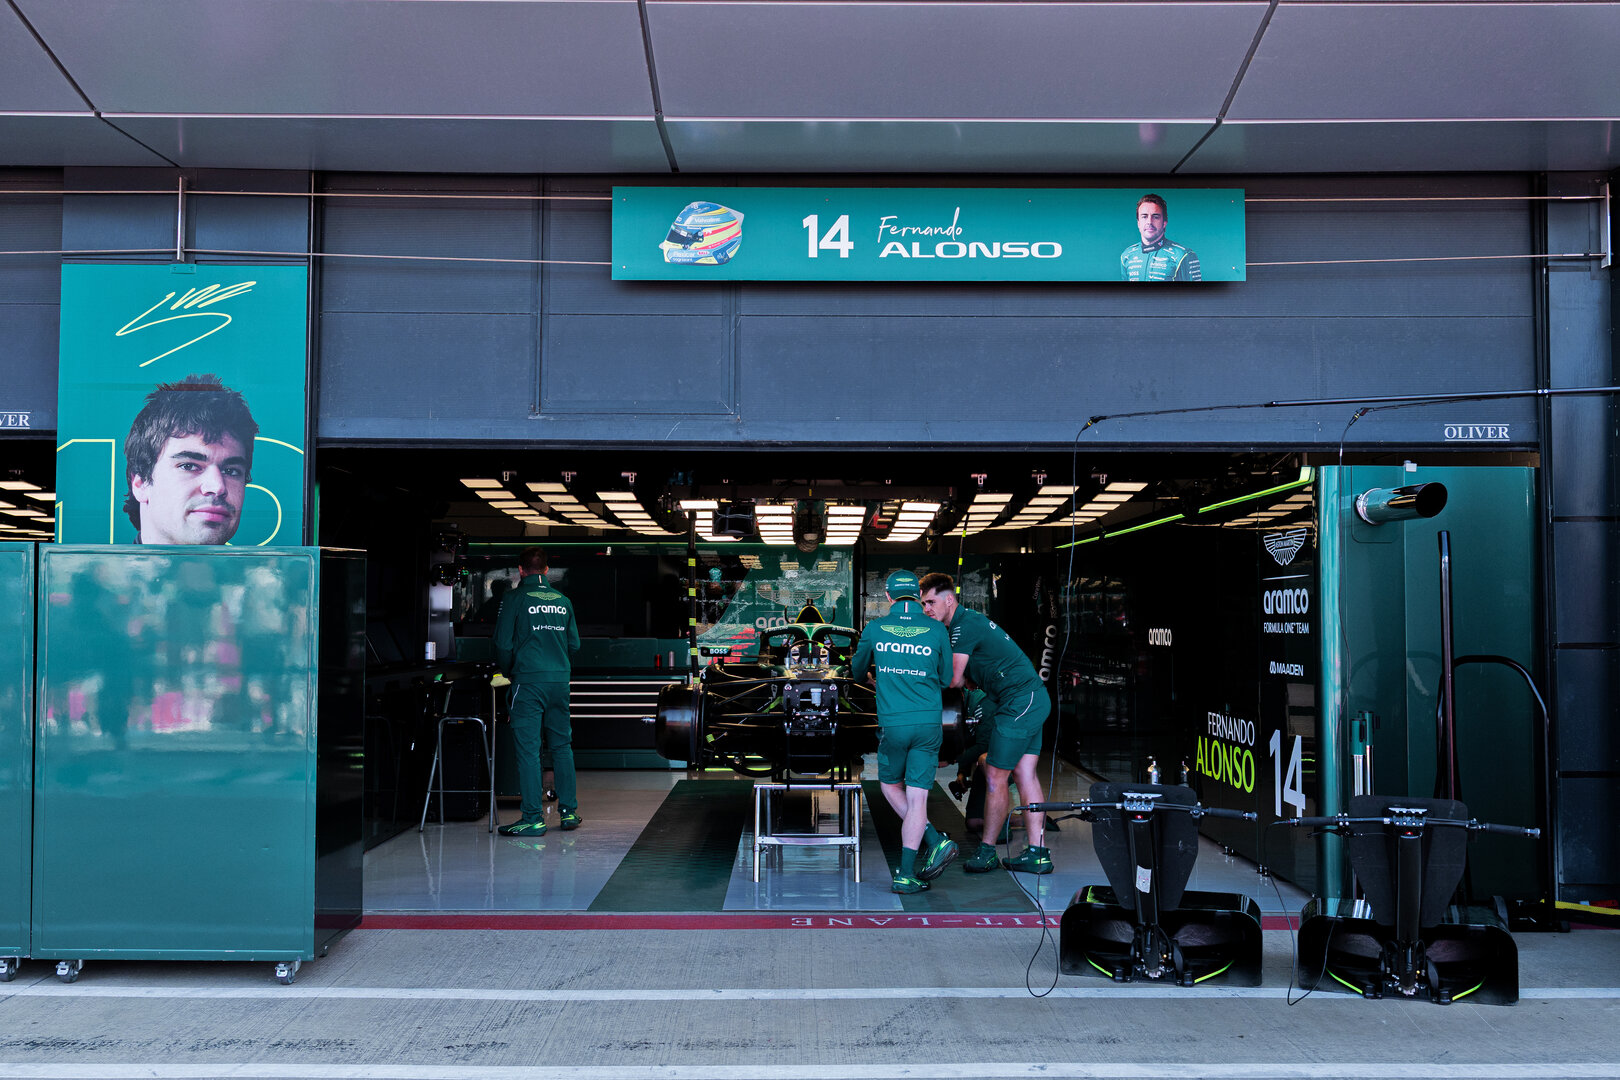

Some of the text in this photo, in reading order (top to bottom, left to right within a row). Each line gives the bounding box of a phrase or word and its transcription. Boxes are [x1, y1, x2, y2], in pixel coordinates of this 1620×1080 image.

[877, 206, 963, 243] Fernando
[803, 214, 854, 258] 14
[878, 241, 1063, 259] ALONSO
[1444, 426, 1510, 439] OLIVER
[528, 604, 567, 615] aramco
[1263, 588, 1309, 614] aramco
[1148, 628, 1172, 647] aramco
[1296, 622, 1309, 634] TEAM
[875, 641, 932, 656] aramco
[1039, 624, 1057, 681] amco
[887, 667, 927, 677] Honda
[1276, 662, 1304, 676] MAADEN
[1208, 711, 1255, 747] FERNANDO
[1196, 735, 1255, 793] ALONSO
[1269, 729, 1306, 818] 14
